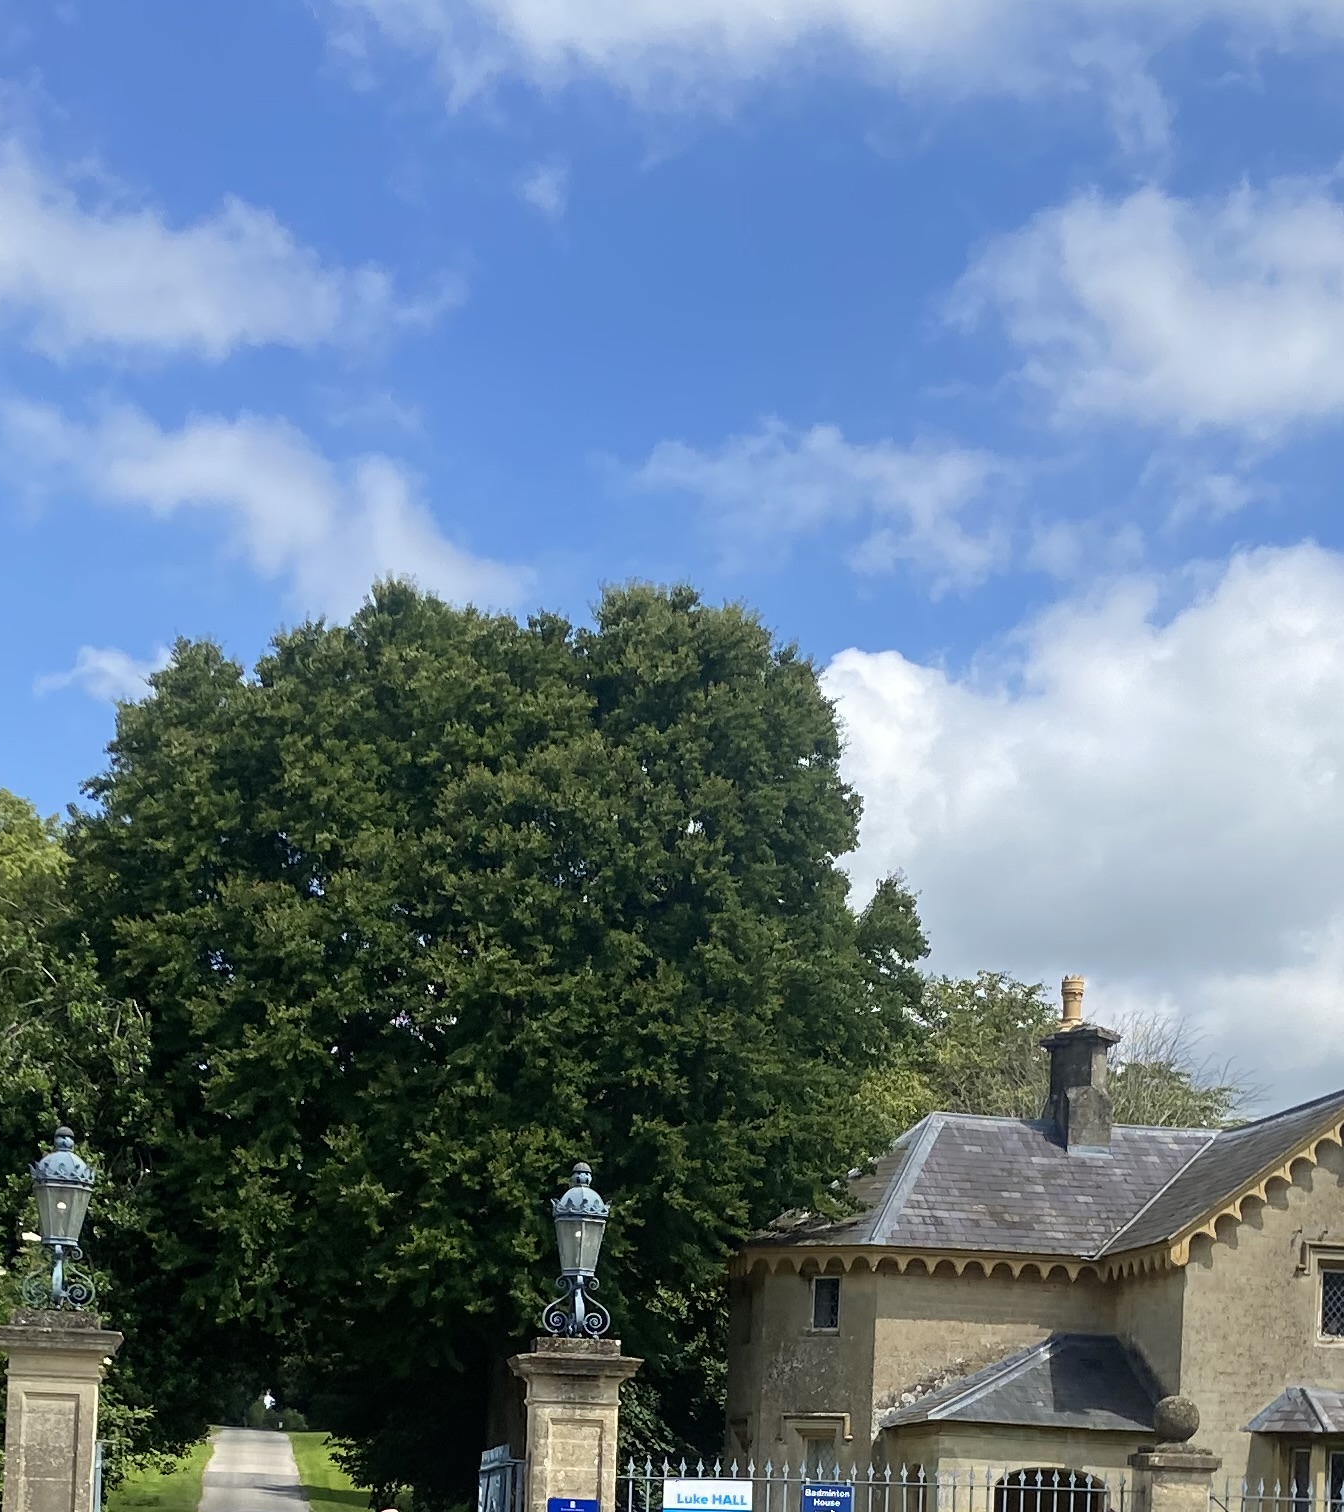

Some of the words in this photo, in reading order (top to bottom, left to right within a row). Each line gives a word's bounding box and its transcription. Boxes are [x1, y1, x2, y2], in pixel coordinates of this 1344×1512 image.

[805, 1488, 850, 1497] Badminton
[676, 1493, 708, 1504] Luke
[712, 1494, 747, 1505] HALL
[813, 1498, 841, 1507] House
